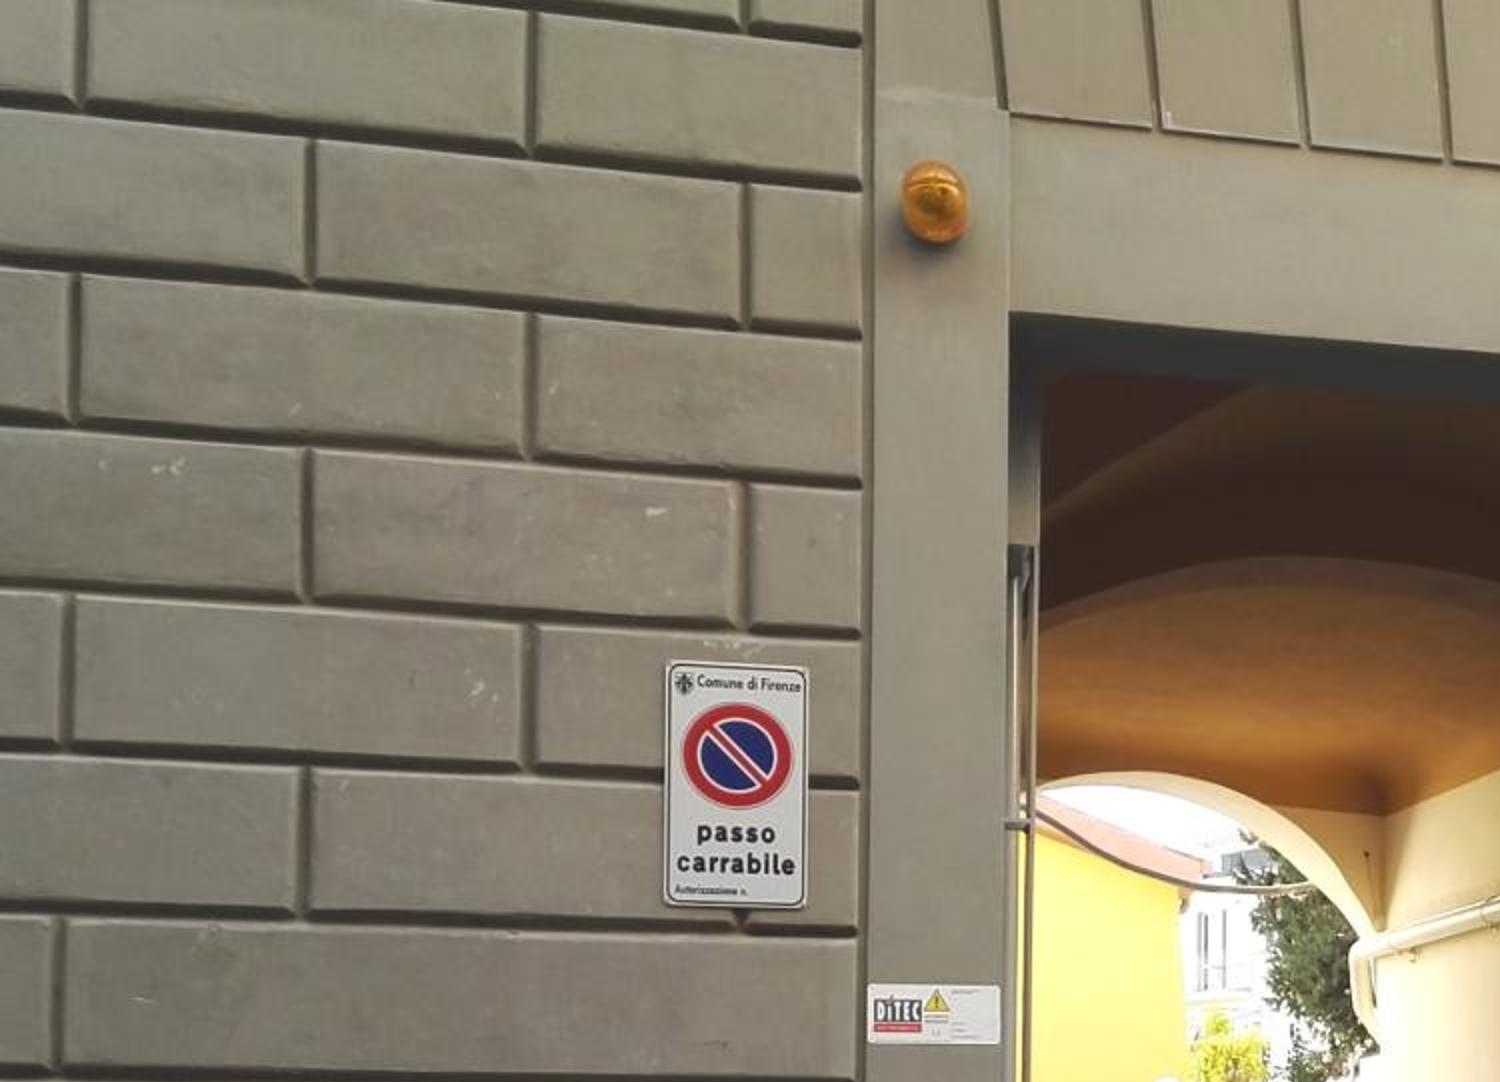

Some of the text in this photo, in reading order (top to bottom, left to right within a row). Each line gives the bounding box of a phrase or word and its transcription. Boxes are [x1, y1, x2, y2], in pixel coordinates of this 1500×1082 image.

[697, 673, 801, 693] Comune di Firenze
[697, 824, 776, 846] passo
[676, 852, 796, 875] carrabile
